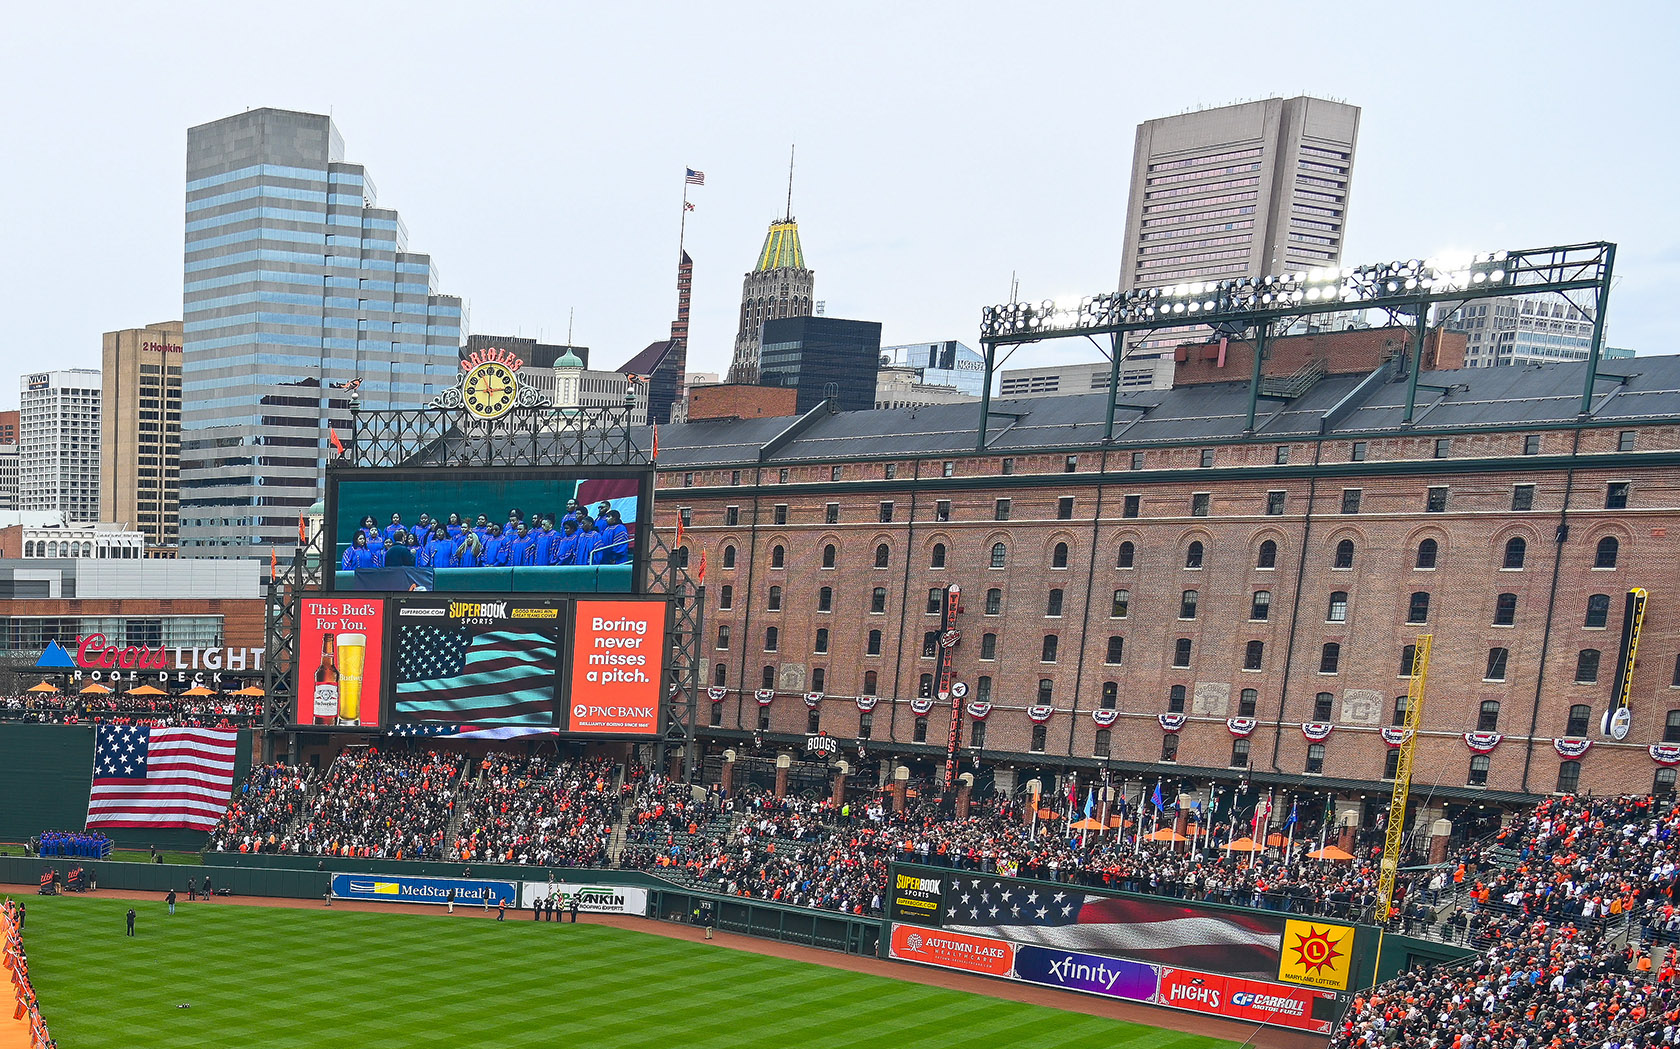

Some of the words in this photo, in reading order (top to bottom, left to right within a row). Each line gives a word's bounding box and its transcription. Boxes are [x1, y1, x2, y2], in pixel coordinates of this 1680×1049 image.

[142, 341, 149, 352] 2
[461, 347, 523, 372] ORIOLES
[308, 603, 339, 615] This
[341, 603, 375, 616] Bud's
[449, 602, 507, 619] SUPERBOOK
[316, 618, 338, 630] For
[340, 618, 367, 630] You.
[592, 616, 647, 635] Boring
[594, 637, 643, 648] never
[75, 632, 169, 669] Coors
[175, 646, 266, 670] LIGHT
[589, 650, 646, 665] misses
[73, 670, 138, 685] ROOF
[160, 671, 222, 683] DECK
[586, 671, 598, 682] a
[601, 667, 650, 685] pitch.
[896, 873, 942, 896] SUPERBOOK
[904, 890, 930, 898] SPORTS
[897, 898, 936, 908] SUPERBOOK.COM
[925, 937, 973, 953] AUTUMN
[974, 945, 1005, 959] LAKE
[935, 949, 994, 963] HEALTHCARE
[1048, 956, 1122, 990] xfinity
[1284, 973, 1315, 983] MARYLAND
[1169, 983, 1221, 1008] HIGH'S
[1254, 993, 1305, 1012] CARROLL
[1251, 1004, 1279, 1013] MOTOR
[1279, 1008, 1303, 1016] FUELS
